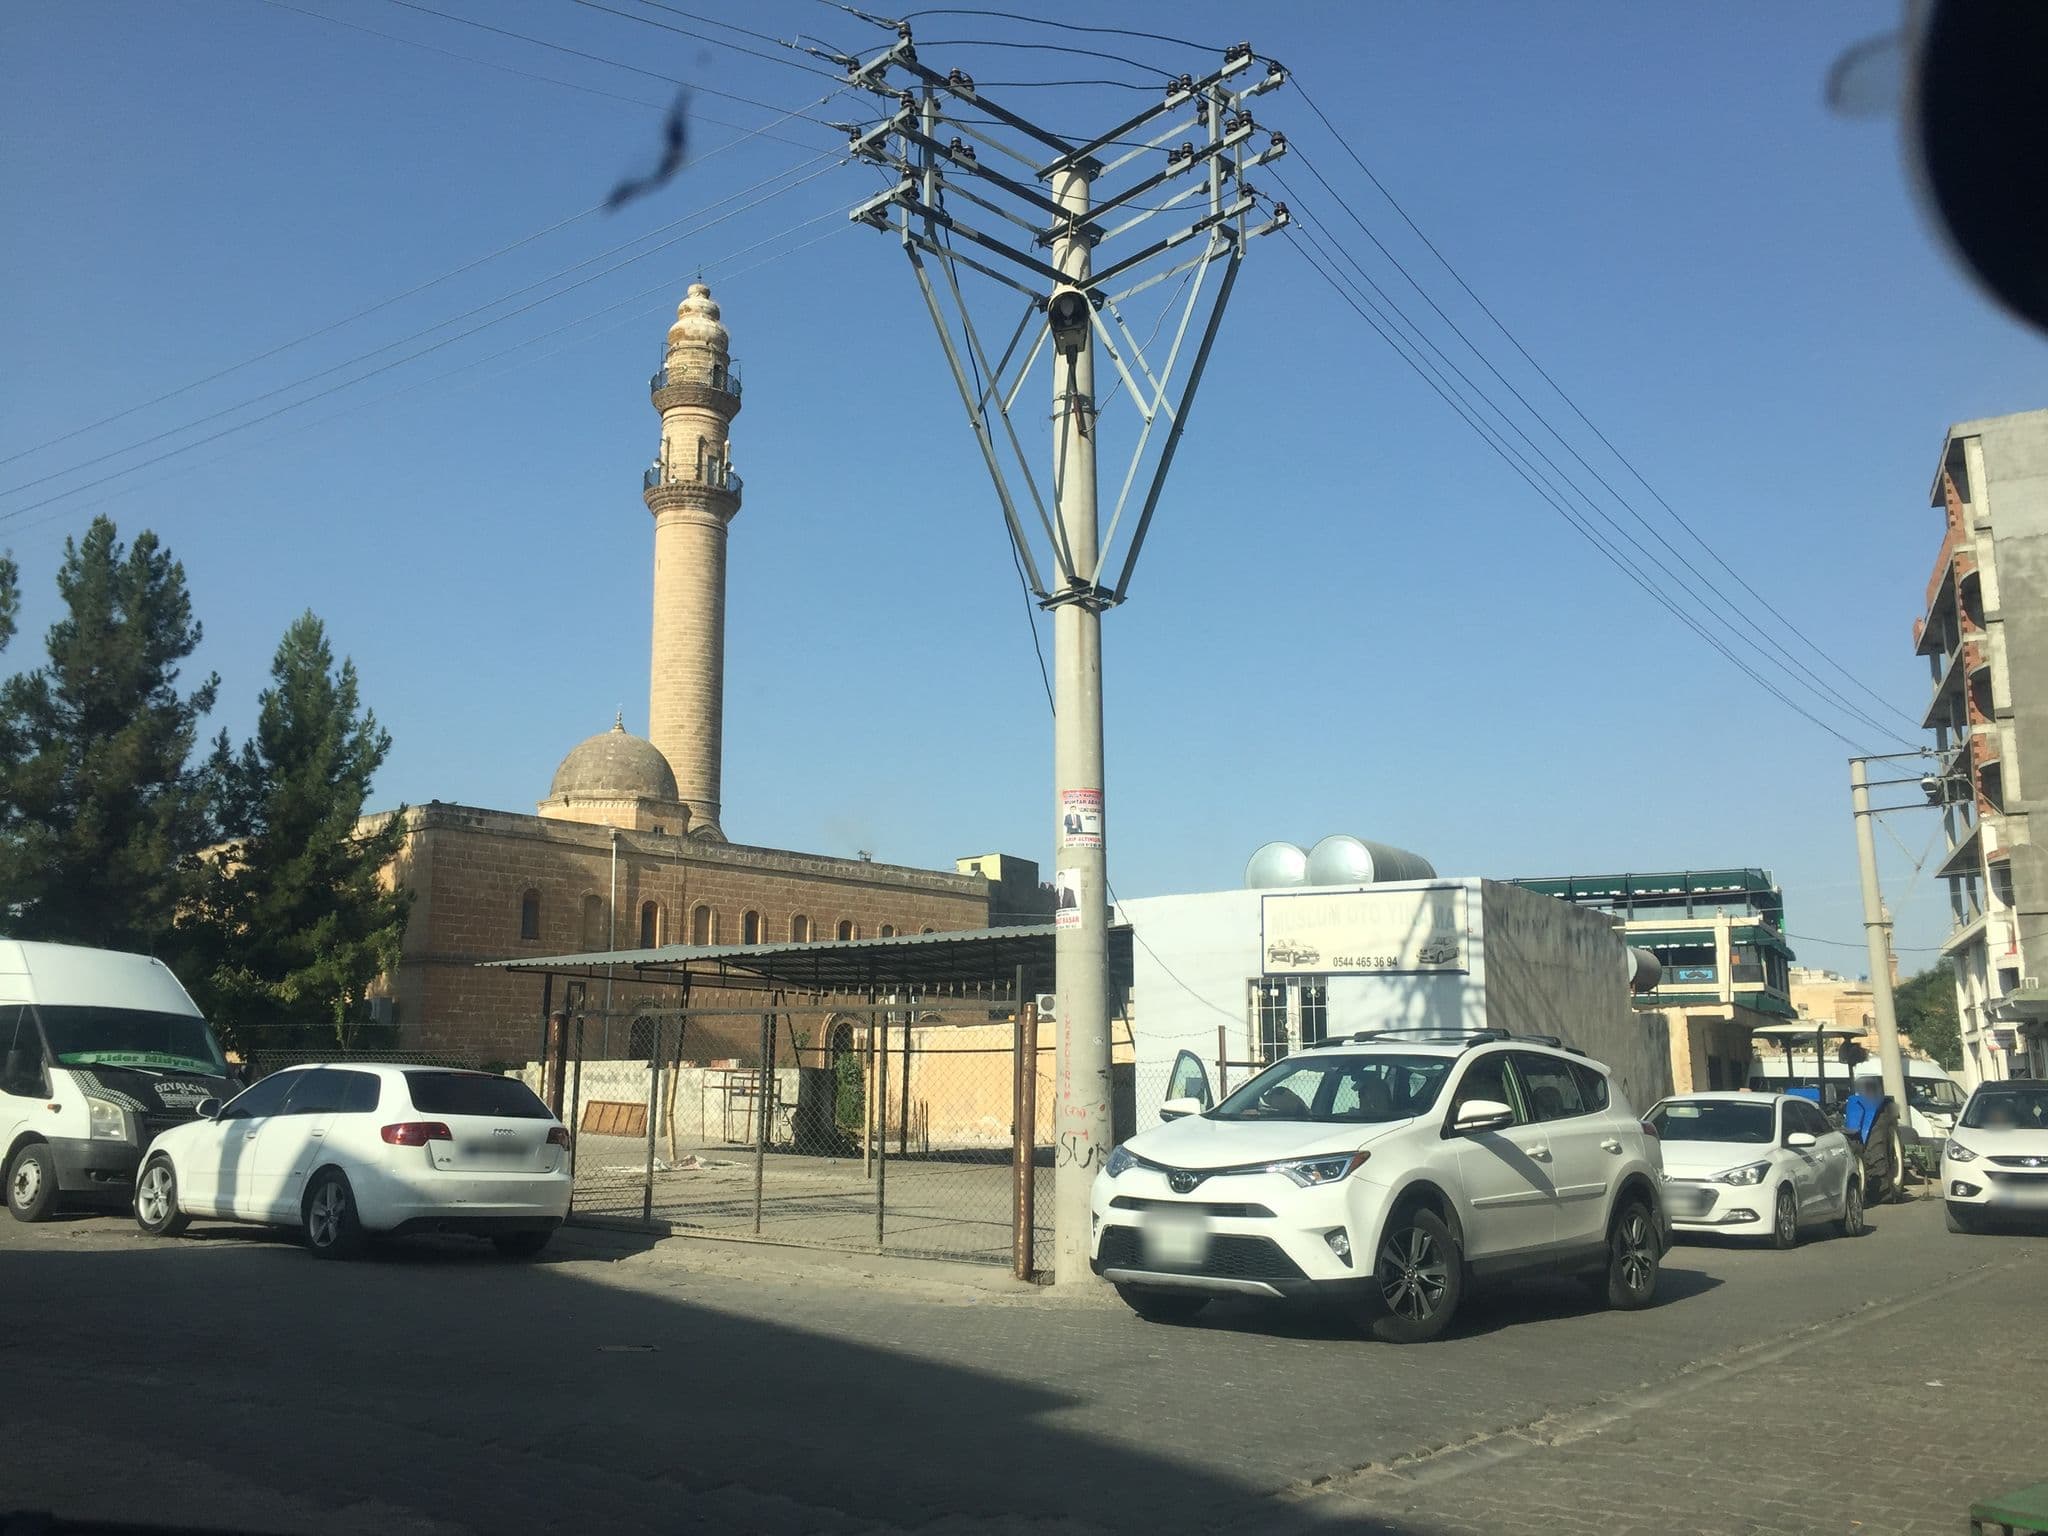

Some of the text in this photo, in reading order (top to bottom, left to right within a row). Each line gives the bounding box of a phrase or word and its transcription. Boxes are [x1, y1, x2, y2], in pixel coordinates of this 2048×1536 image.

[1333, 956, 1397, 967] 0544 465 36 94
